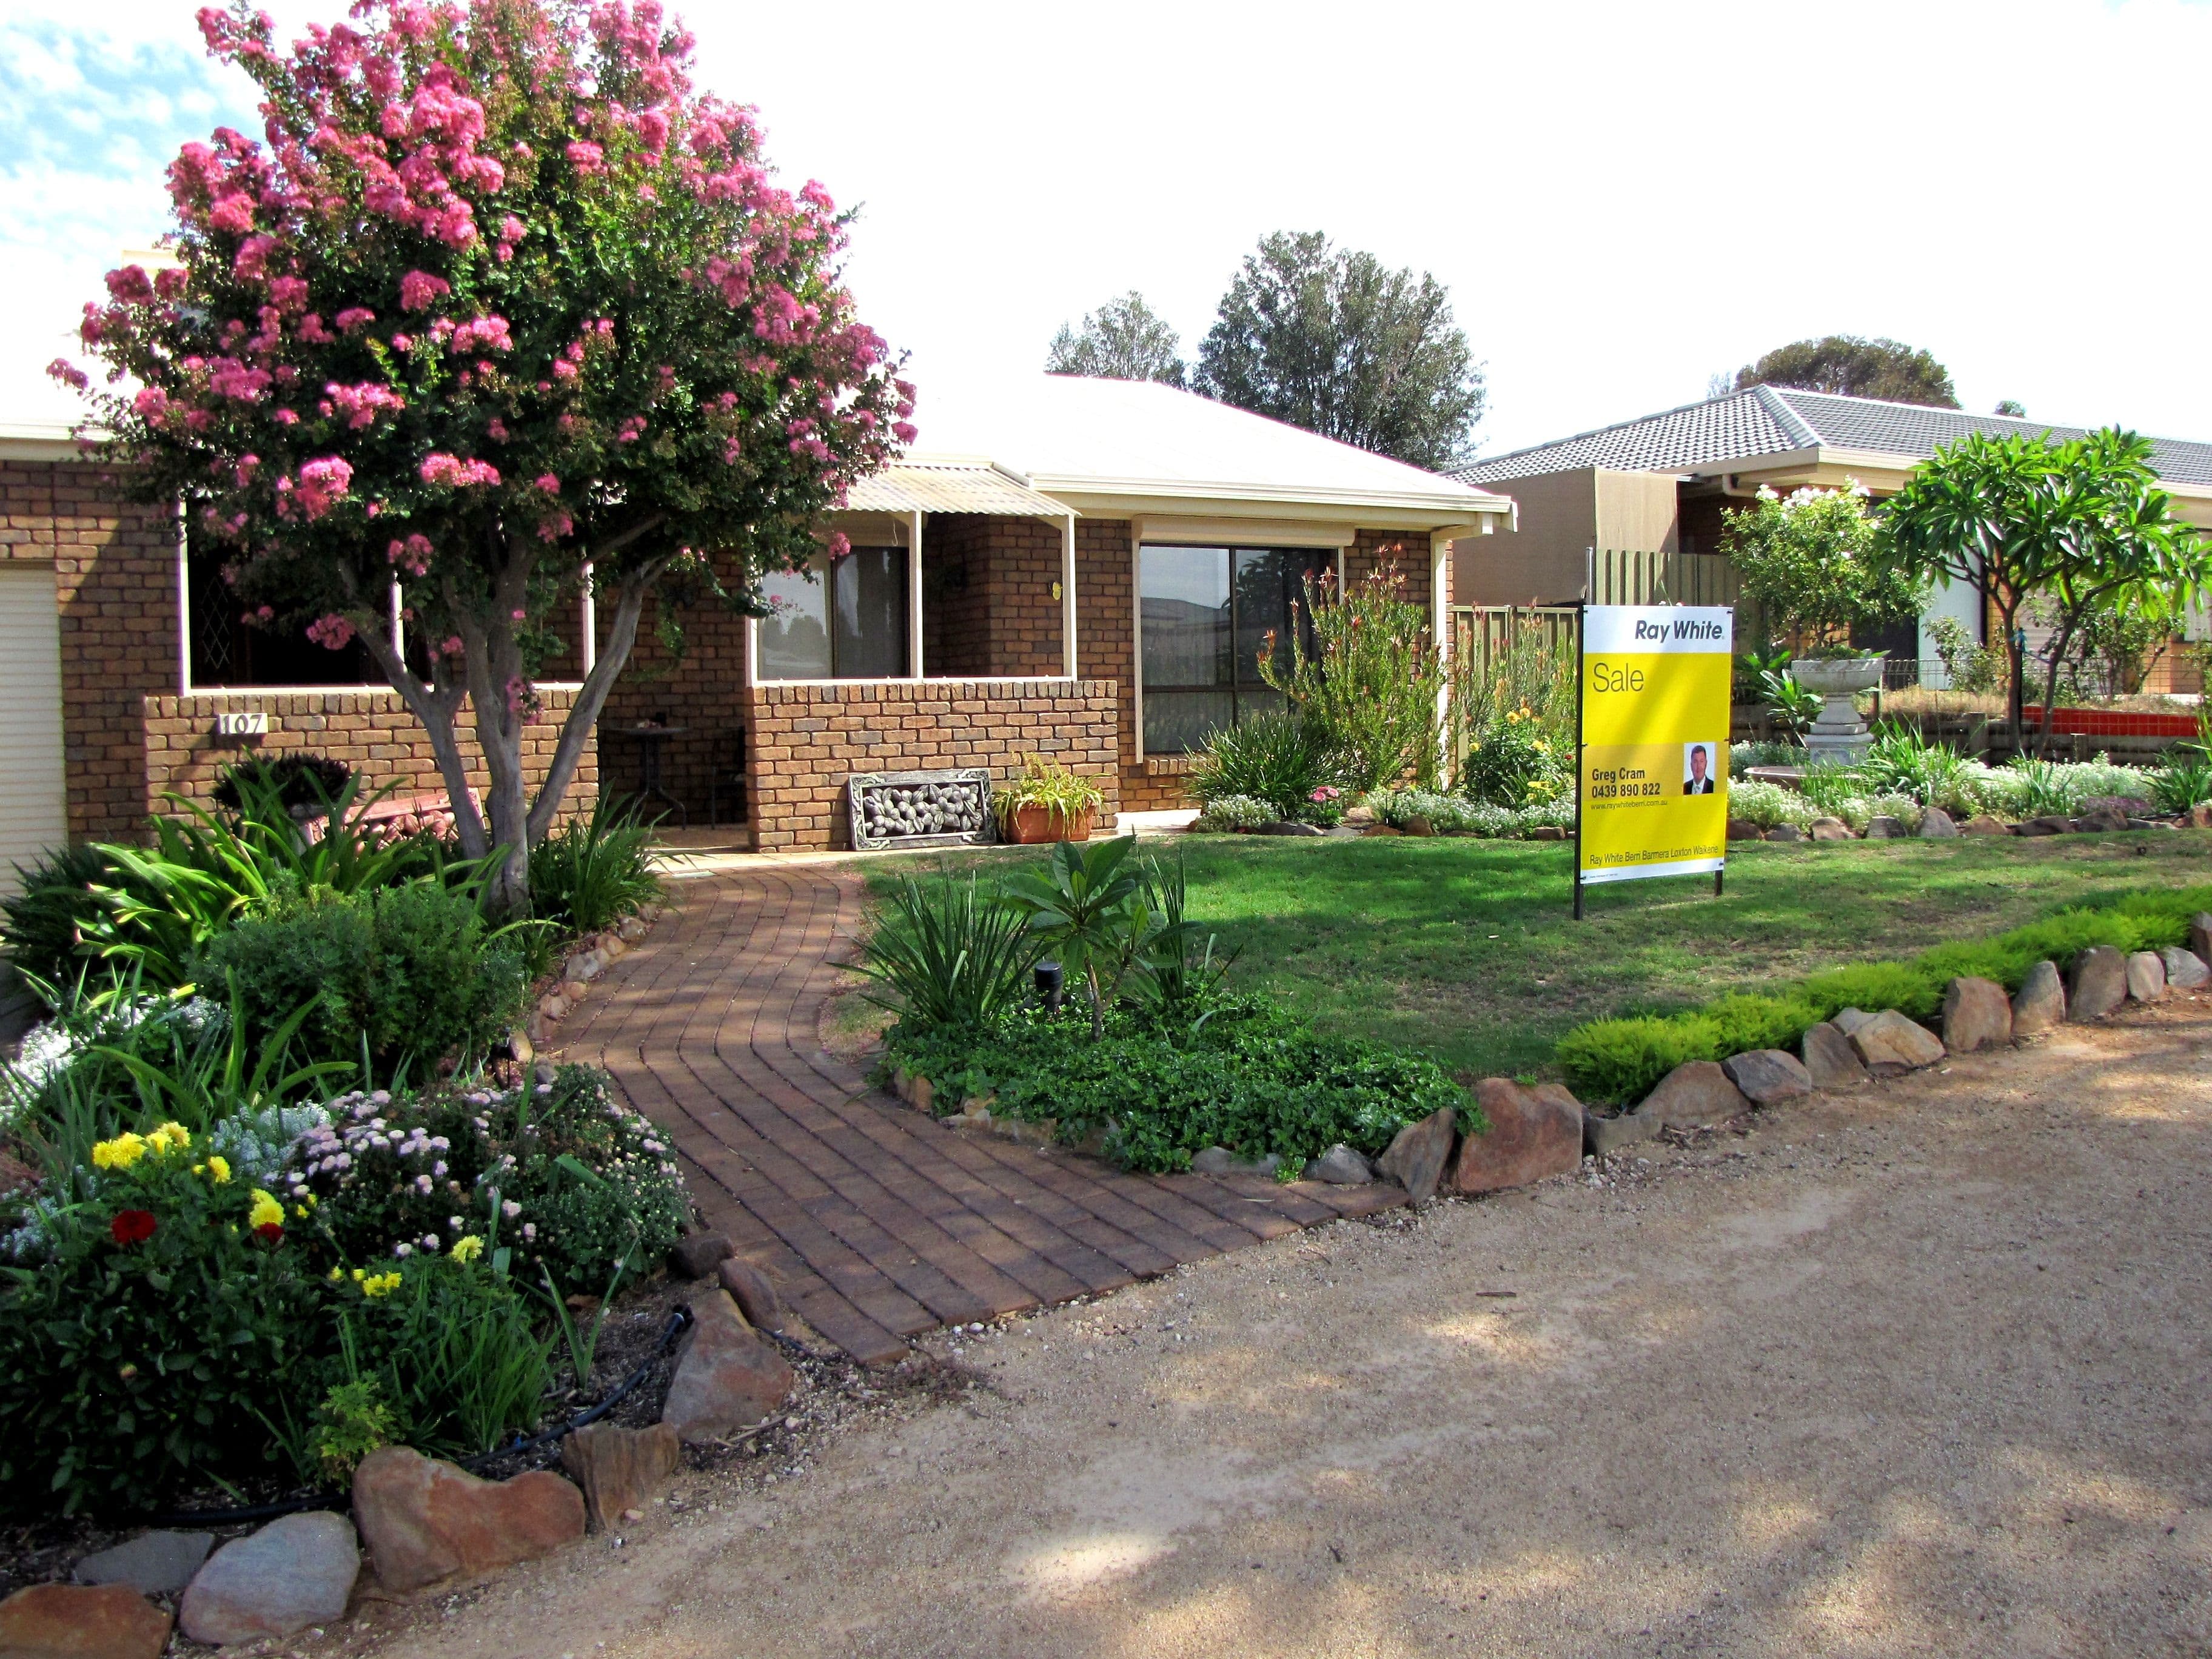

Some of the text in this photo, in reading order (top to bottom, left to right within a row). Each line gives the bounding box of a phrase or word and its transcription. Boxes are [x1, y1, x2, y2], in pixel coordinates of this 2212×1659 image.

[1635, 620, 1723, 643] Ray White
[1592, 662, 1644, 692] Sale
[224, 714, 263, 734] 107
[1592, 767, 1645, 783] Greg Cram
[1592, 782, 1660, 798] 0439 890 822
[1590, 800, 1667, 810] www.raywhiteberri.com.au
[1590, 854, 1603, 866] Ray
[1604, 853, 1623, 863] White
[1625, 851, 1640, 862] Berri
[1642, 850, 1669, 860] Barmera
[1671, 847, 1692, 857] Loxton
